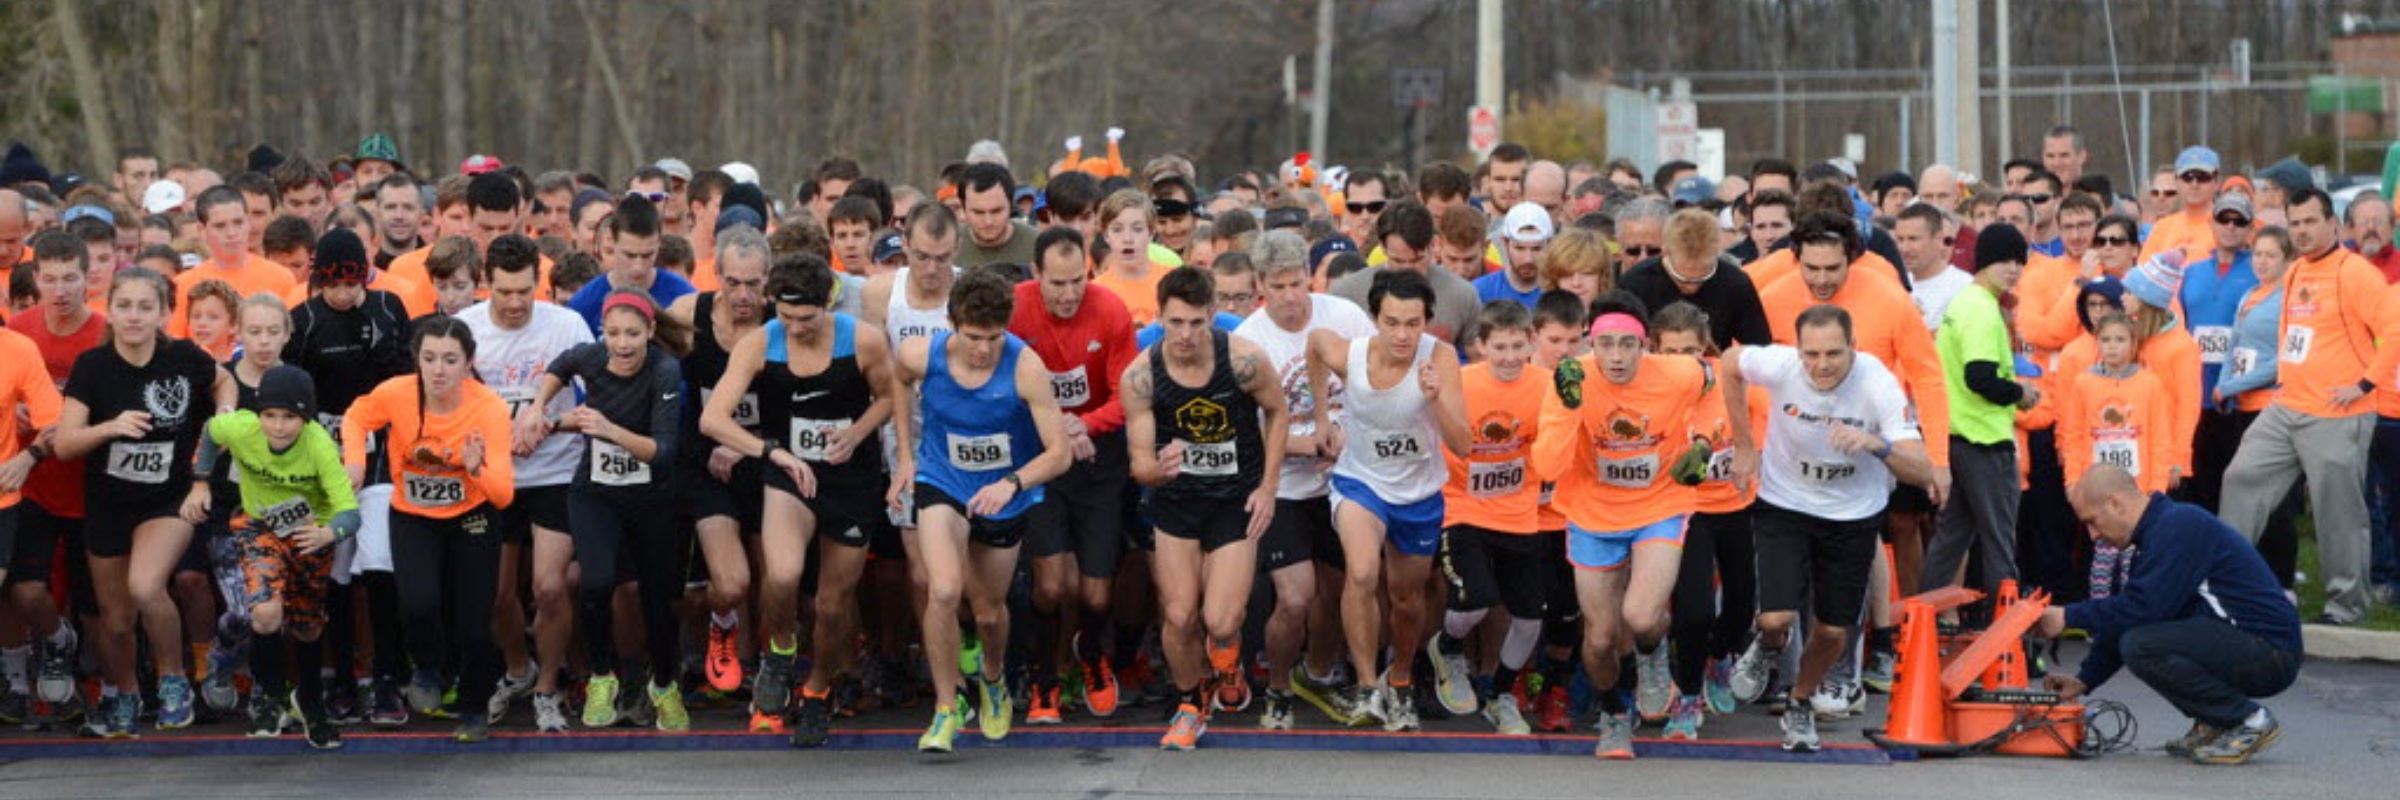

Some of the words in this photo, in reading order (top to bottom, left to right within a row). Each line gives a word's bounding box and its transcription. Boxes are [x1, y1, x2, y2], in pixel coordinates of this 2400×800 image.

[957, 444, 1001, 462] 559
[1374, 438, 1419, 458] 524
[119, 451, 162, 472] 703
[1606, 462, 1651, 480] 905
[1471, 466, 1522, 491] 1050
